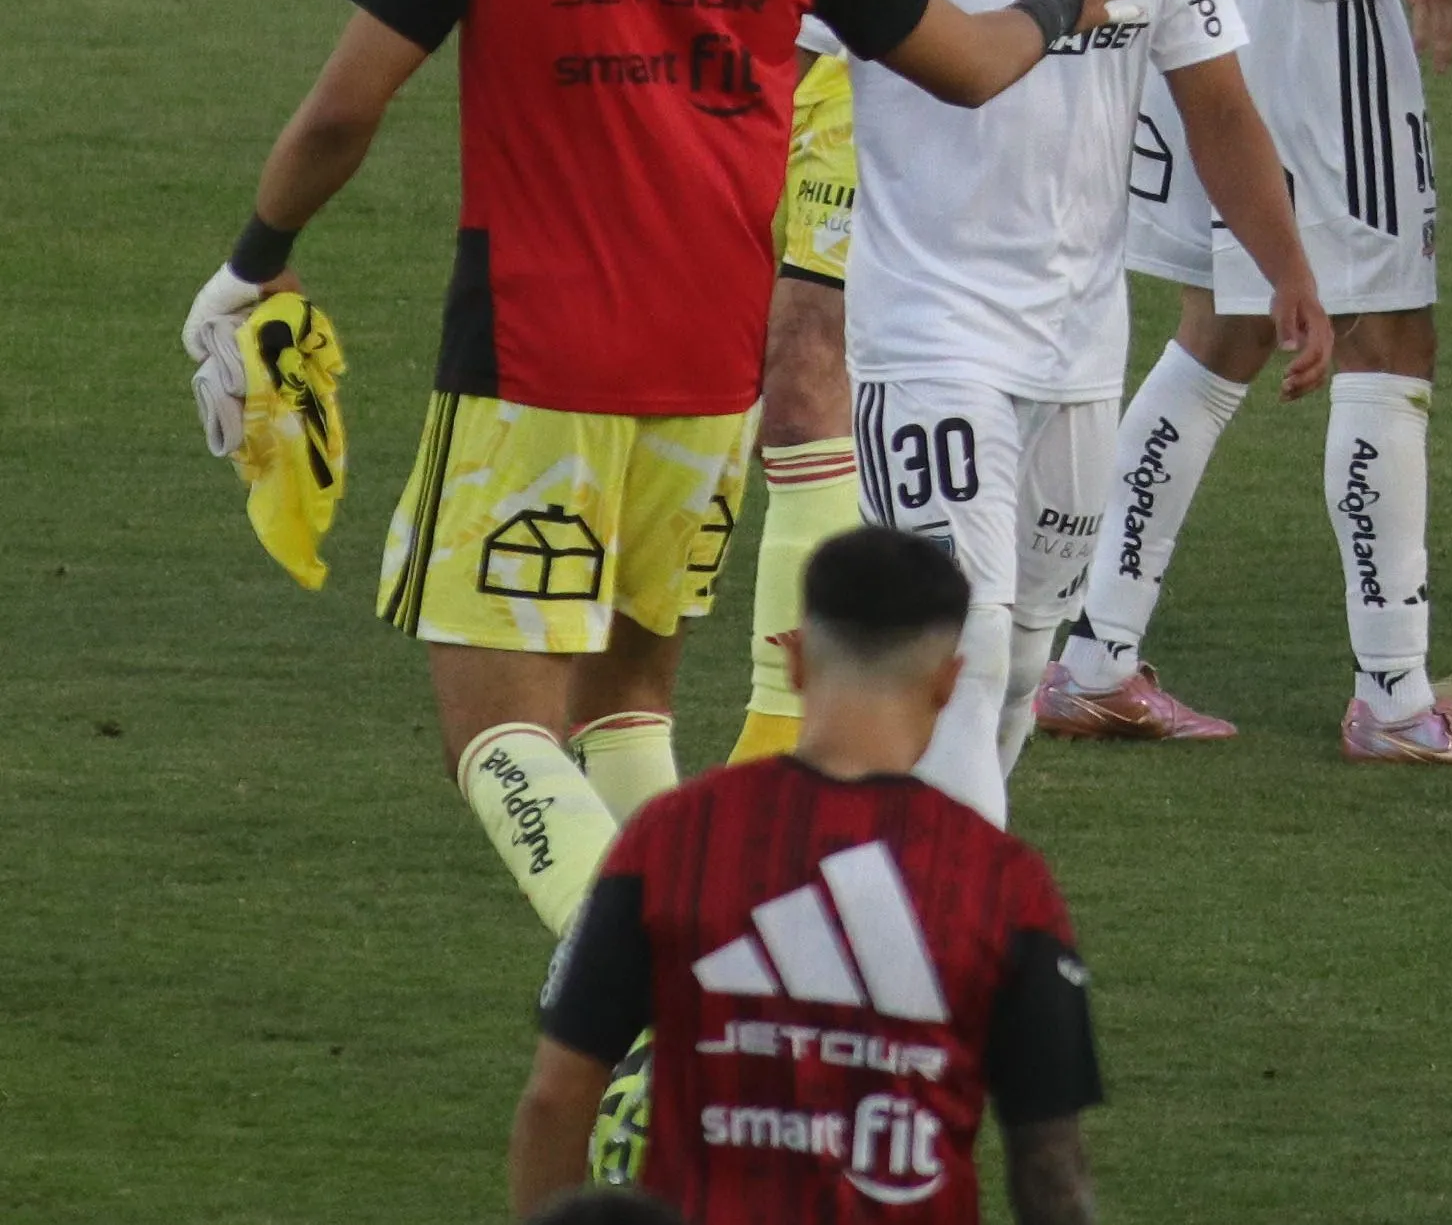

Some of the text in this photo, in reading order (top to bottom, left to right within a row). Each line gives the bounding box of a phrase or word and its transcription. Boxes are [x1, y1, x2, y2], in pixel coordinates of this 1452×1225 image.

[798, 179, 855, 208] PHILI
[891, 417, 979, 509] 30
[1031, 533, 1058, 555] TV
[695, 1019, 950, 1081] JETOUR
